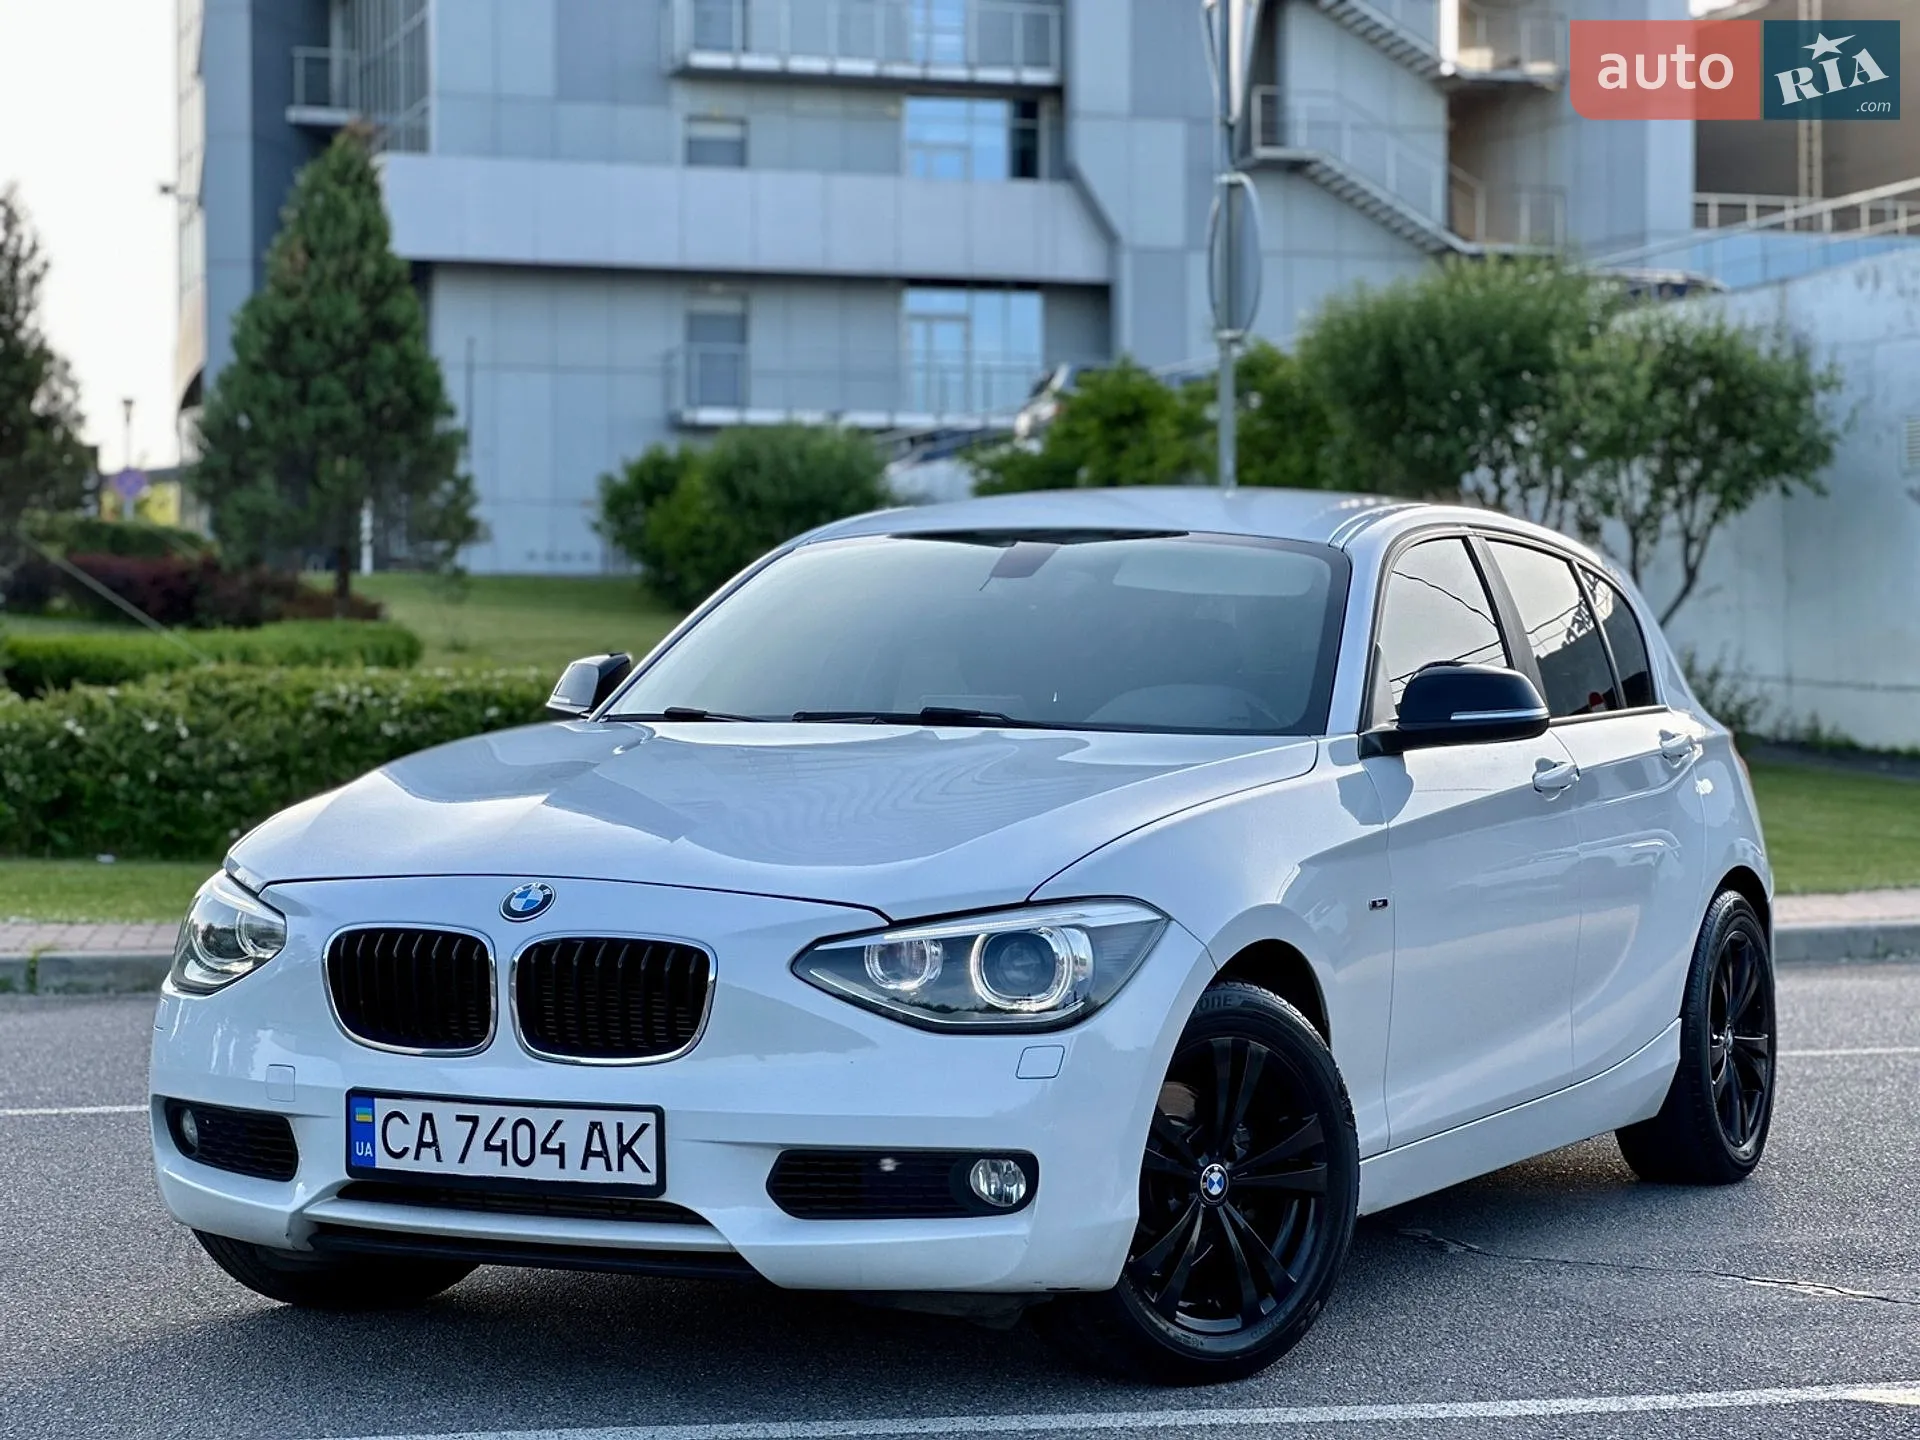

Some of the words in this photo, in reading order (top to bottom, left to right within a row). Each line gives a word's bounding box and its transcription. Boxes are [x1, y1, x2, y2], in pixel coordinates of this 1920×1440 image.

[355, 1141, 373, 1158] UA
[381, 1110, 443, 1163] CA
[455, 1114, 566, 1169] 7404
[580, 1120, 651, 1173] AK
